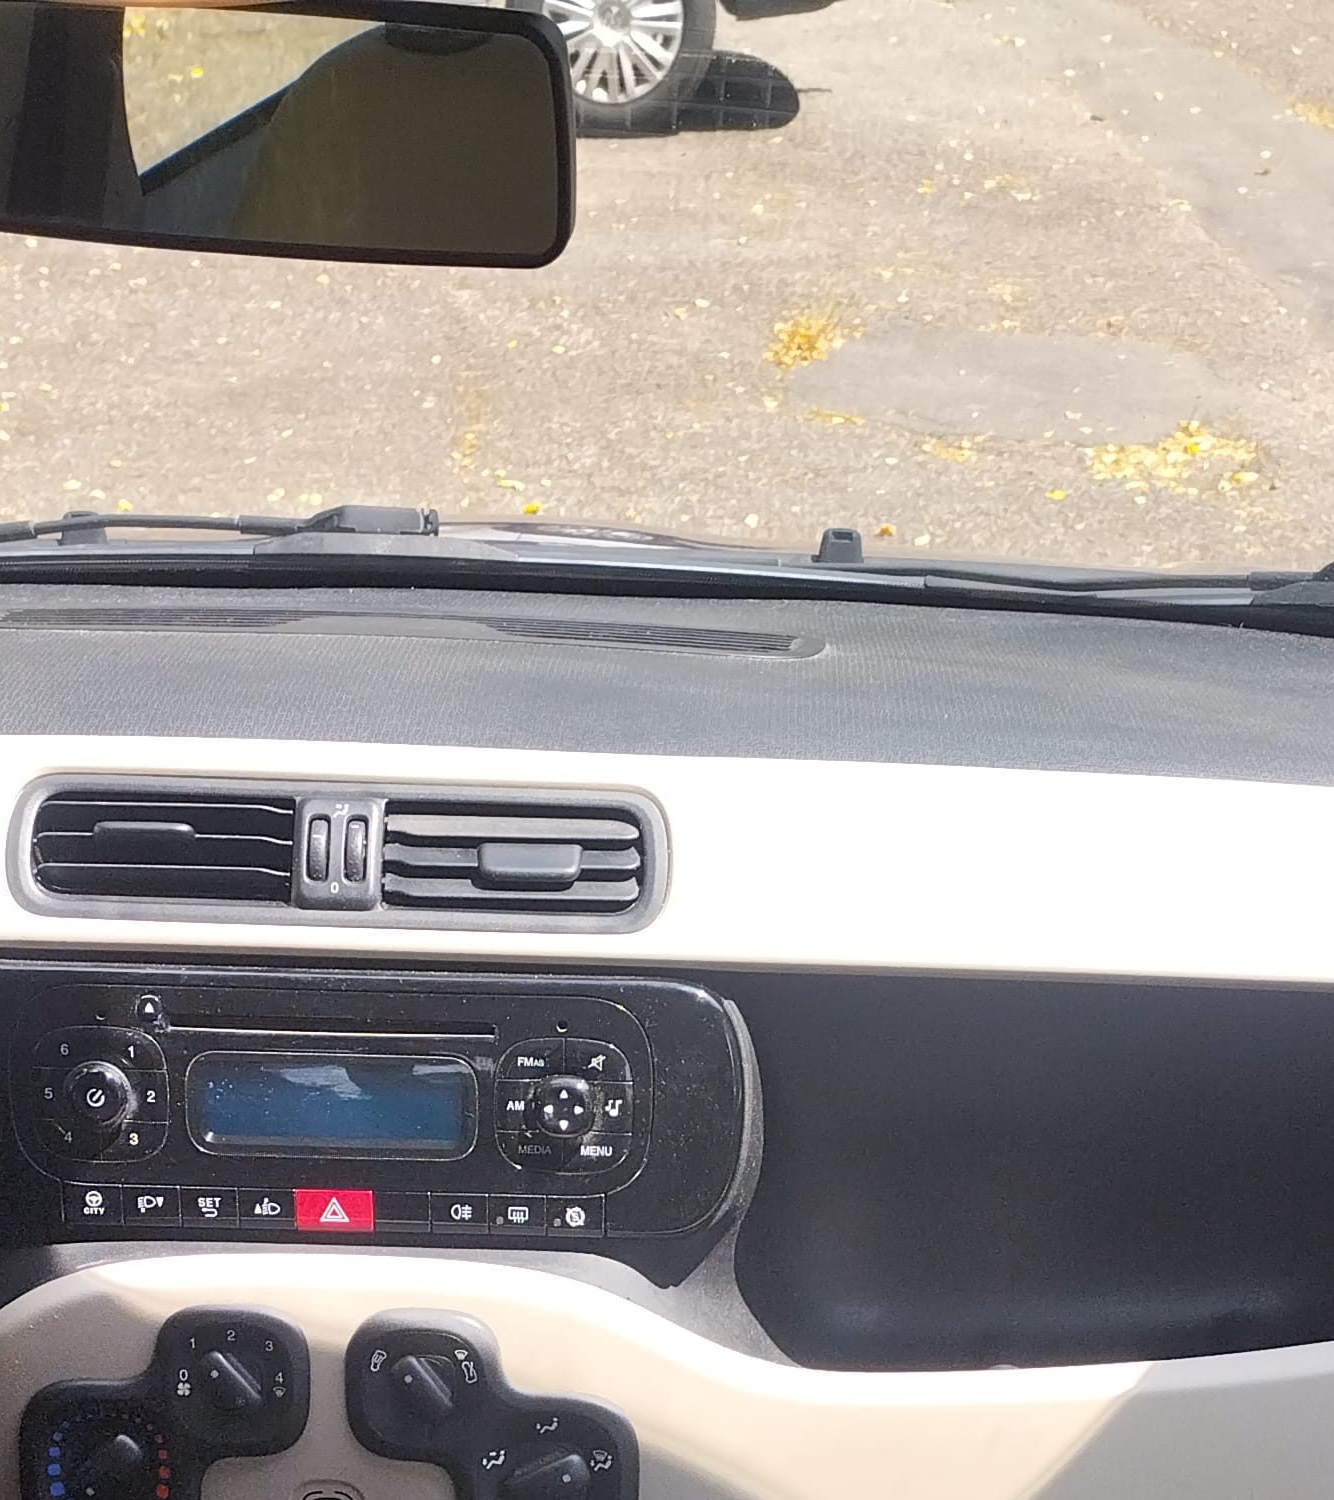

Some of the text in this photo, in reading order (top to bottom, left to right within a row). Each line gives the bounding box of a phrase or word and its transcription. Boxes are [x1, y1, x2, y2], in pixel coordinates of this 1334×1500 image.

[60, 1043, 69, 1056] 6
[127, 1045, 135, 1058] 1
[44, 1087, 54, 1100] 5
[146, 1090, 156, 1103] 2
[506, 1100, 525, 1111] AM
[64, 1131, 73, 1143] 4
[129, 1132, 139, 1146] 3
[517, 1144, 552, 1155] MEDIA
[580, 1145, 613, 1157] MENU
[197, 1197, 221, 1208] SET
[83, 1206, 105, 1215] CITY
[226, 1329, 236, 1342] 2
[189, 1337, 196, 1349] 1
[265, 1340, 274, 1352] 3
[178, 1368, 189, 1382] 0
[274, 1371, 284, 1384] 4
